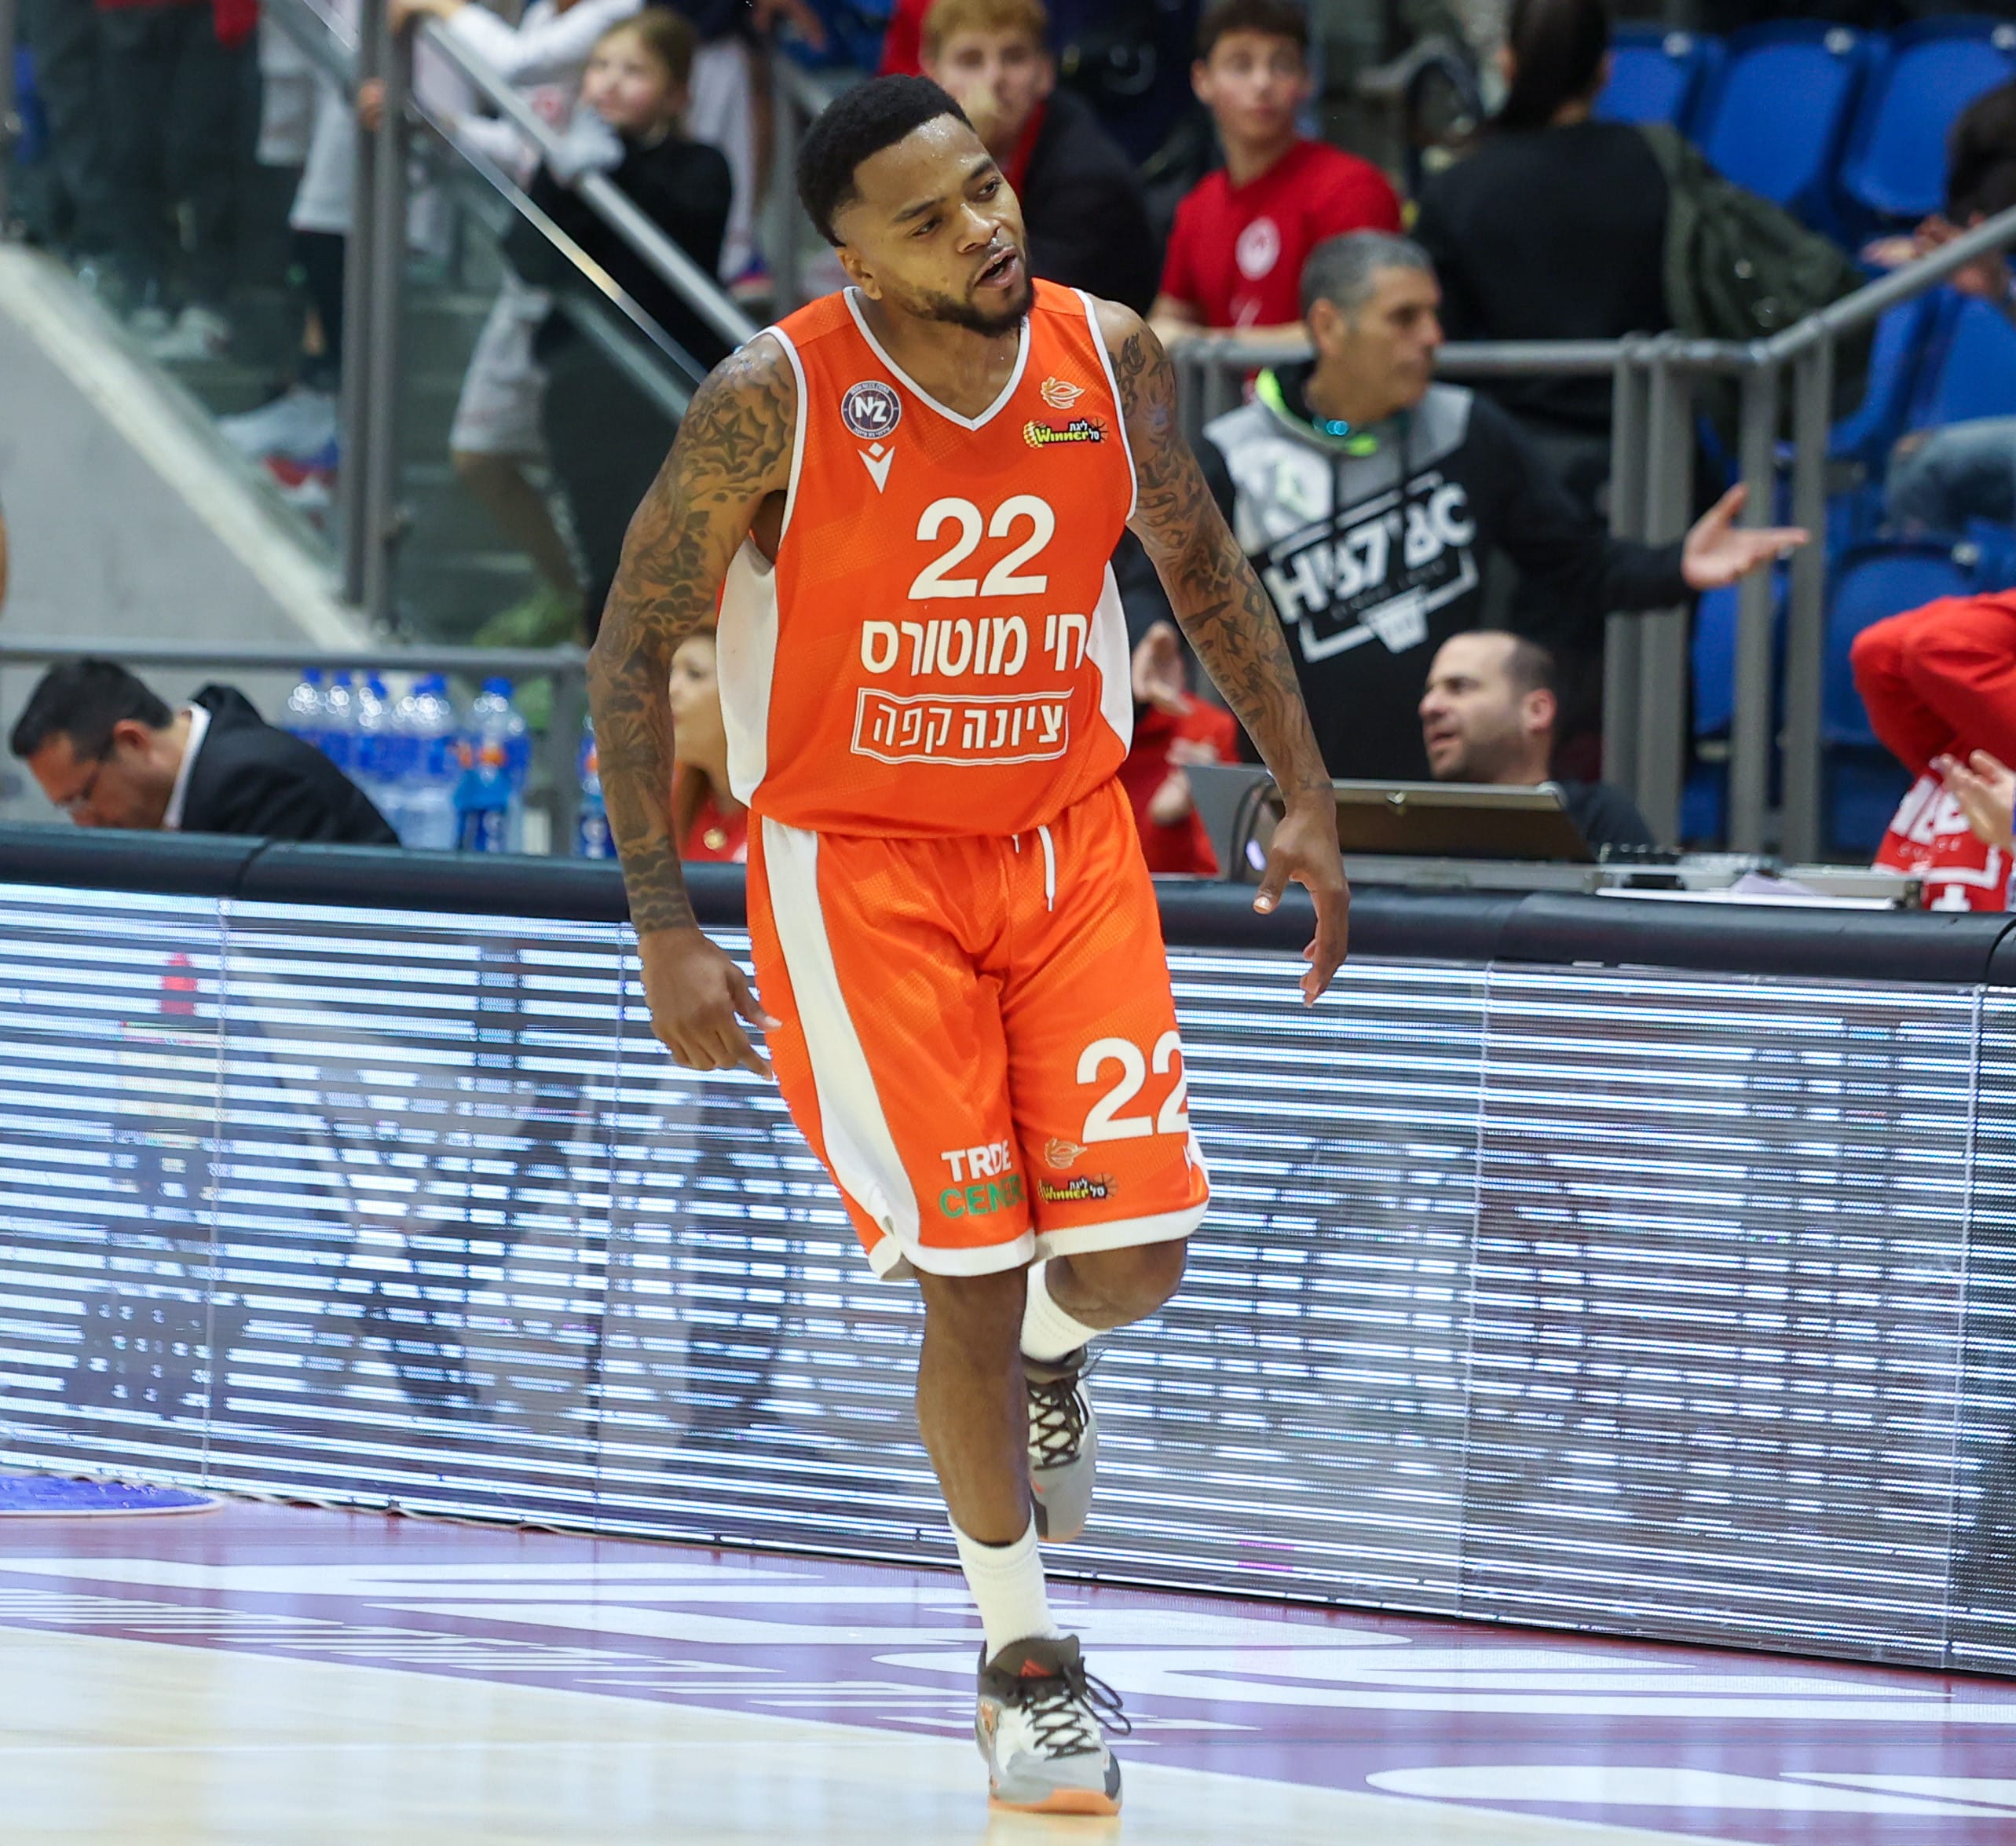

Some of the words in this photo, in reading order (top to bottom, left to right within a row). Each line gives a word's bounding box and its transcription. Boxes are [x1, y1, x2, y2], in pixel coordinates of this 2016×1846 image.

[855, 396, 887, 422] NZ
[1069, 420, 1088, 431] ליגת
[907, 494, 1056, 600] 22
[860, 616, 1029, 677] מוטורס
[1044, 613, 1088, 672] חי
[873, 703, 953, 754] קפה
[962, 704, 1064, 749] ציונה
[1077, 1030, 1189, 1144] 22
